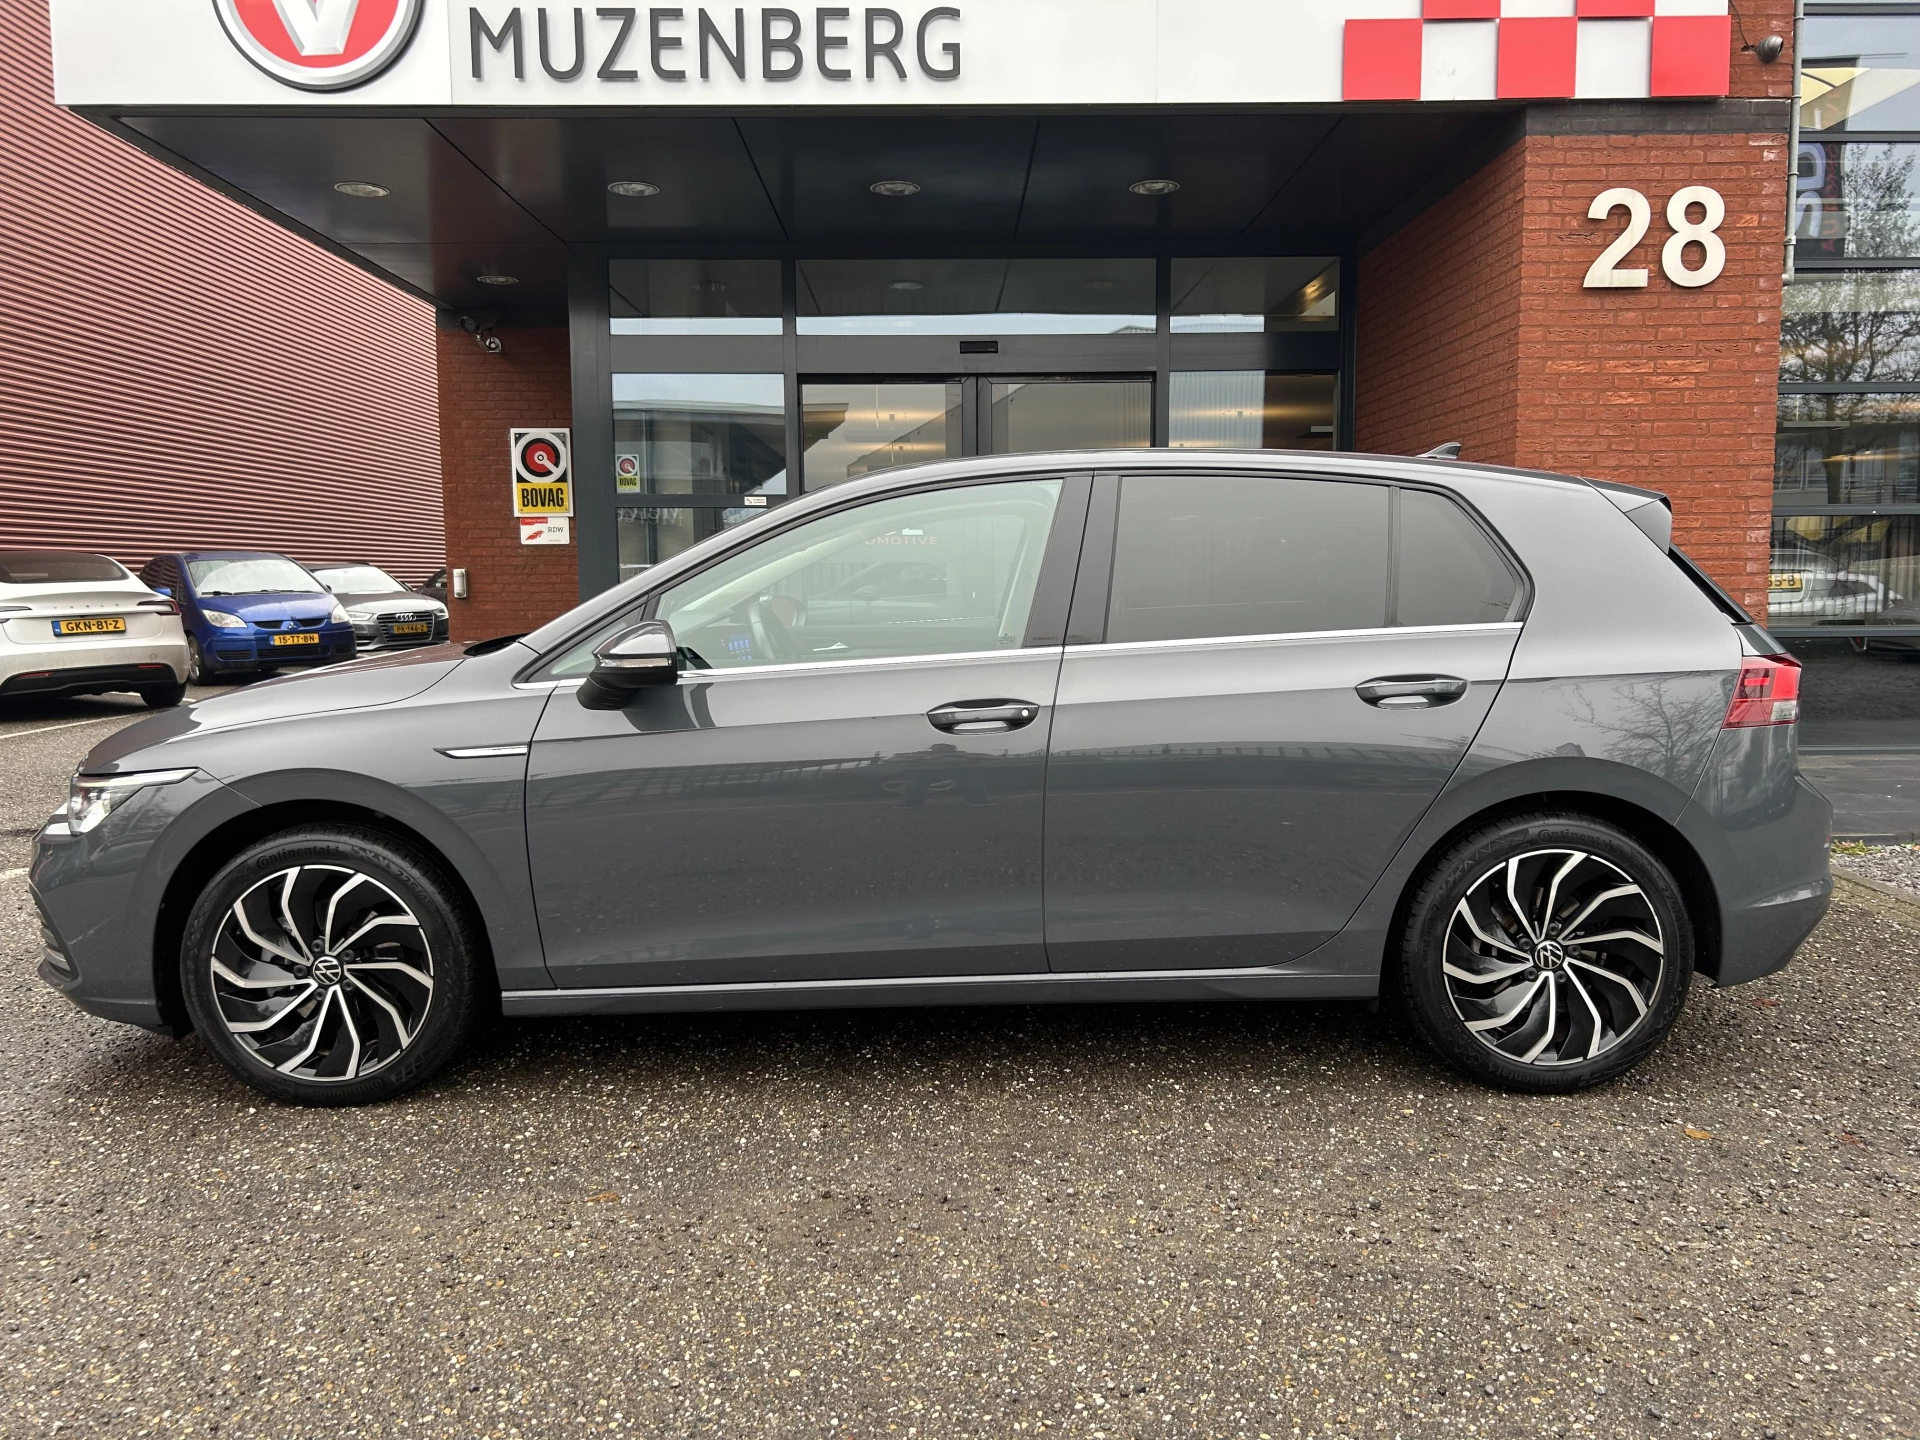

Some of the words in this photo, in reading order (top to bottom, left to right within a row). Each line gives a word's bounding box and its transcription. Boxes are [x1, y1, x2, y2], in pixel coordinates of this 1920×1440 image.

[470, 7, 960, 81] MUZENBERG
[1583, 186, 1726, 288] 28
[619, 477, 637, 487] BOVAG
[521, 487, 564, 508] BOVAG
[66, 619, 121, 632] GKN-81-Z
[278, 633, 315, 644] 15-TT-BN
[257, 845, 330, 868] Continental
